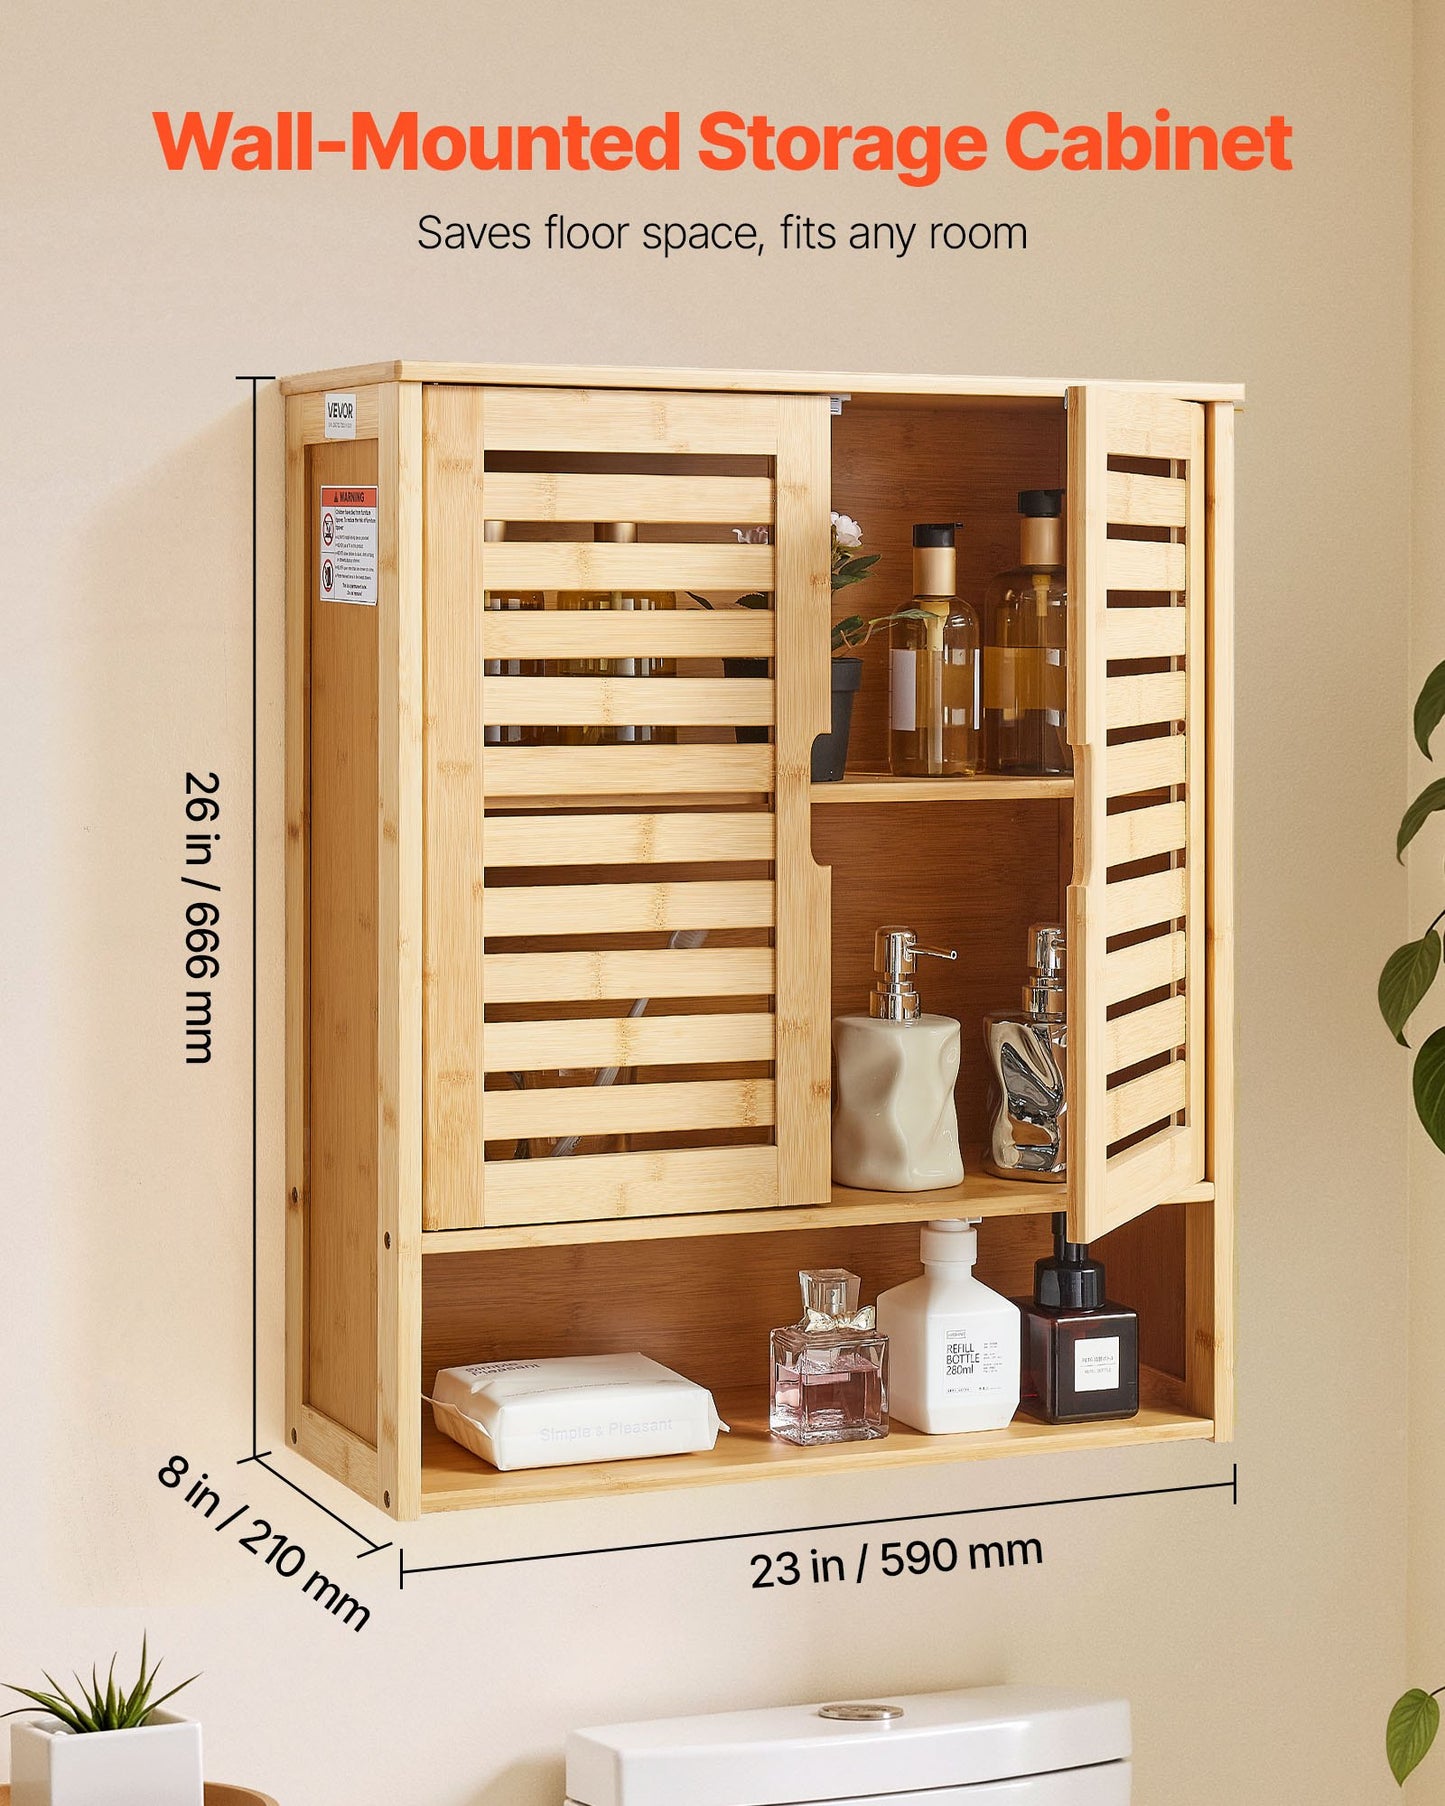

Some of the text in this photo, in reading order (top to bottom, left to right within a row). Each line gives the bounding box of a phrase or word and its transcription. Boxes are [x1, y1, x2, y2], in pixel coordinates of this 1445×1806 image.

[327, 402, 353, 418] VEVOR
[340, 491, 365, 502] WARNING
[946, 1343, 975, 1354] REFILL
[946, 1353, 980, 1365] BOTTLE
[946, 1364, 974, 1376] 280ml
[539, 1425, 592, 1443] Simple
[608, 1418, 673, 1436] Pleasant
